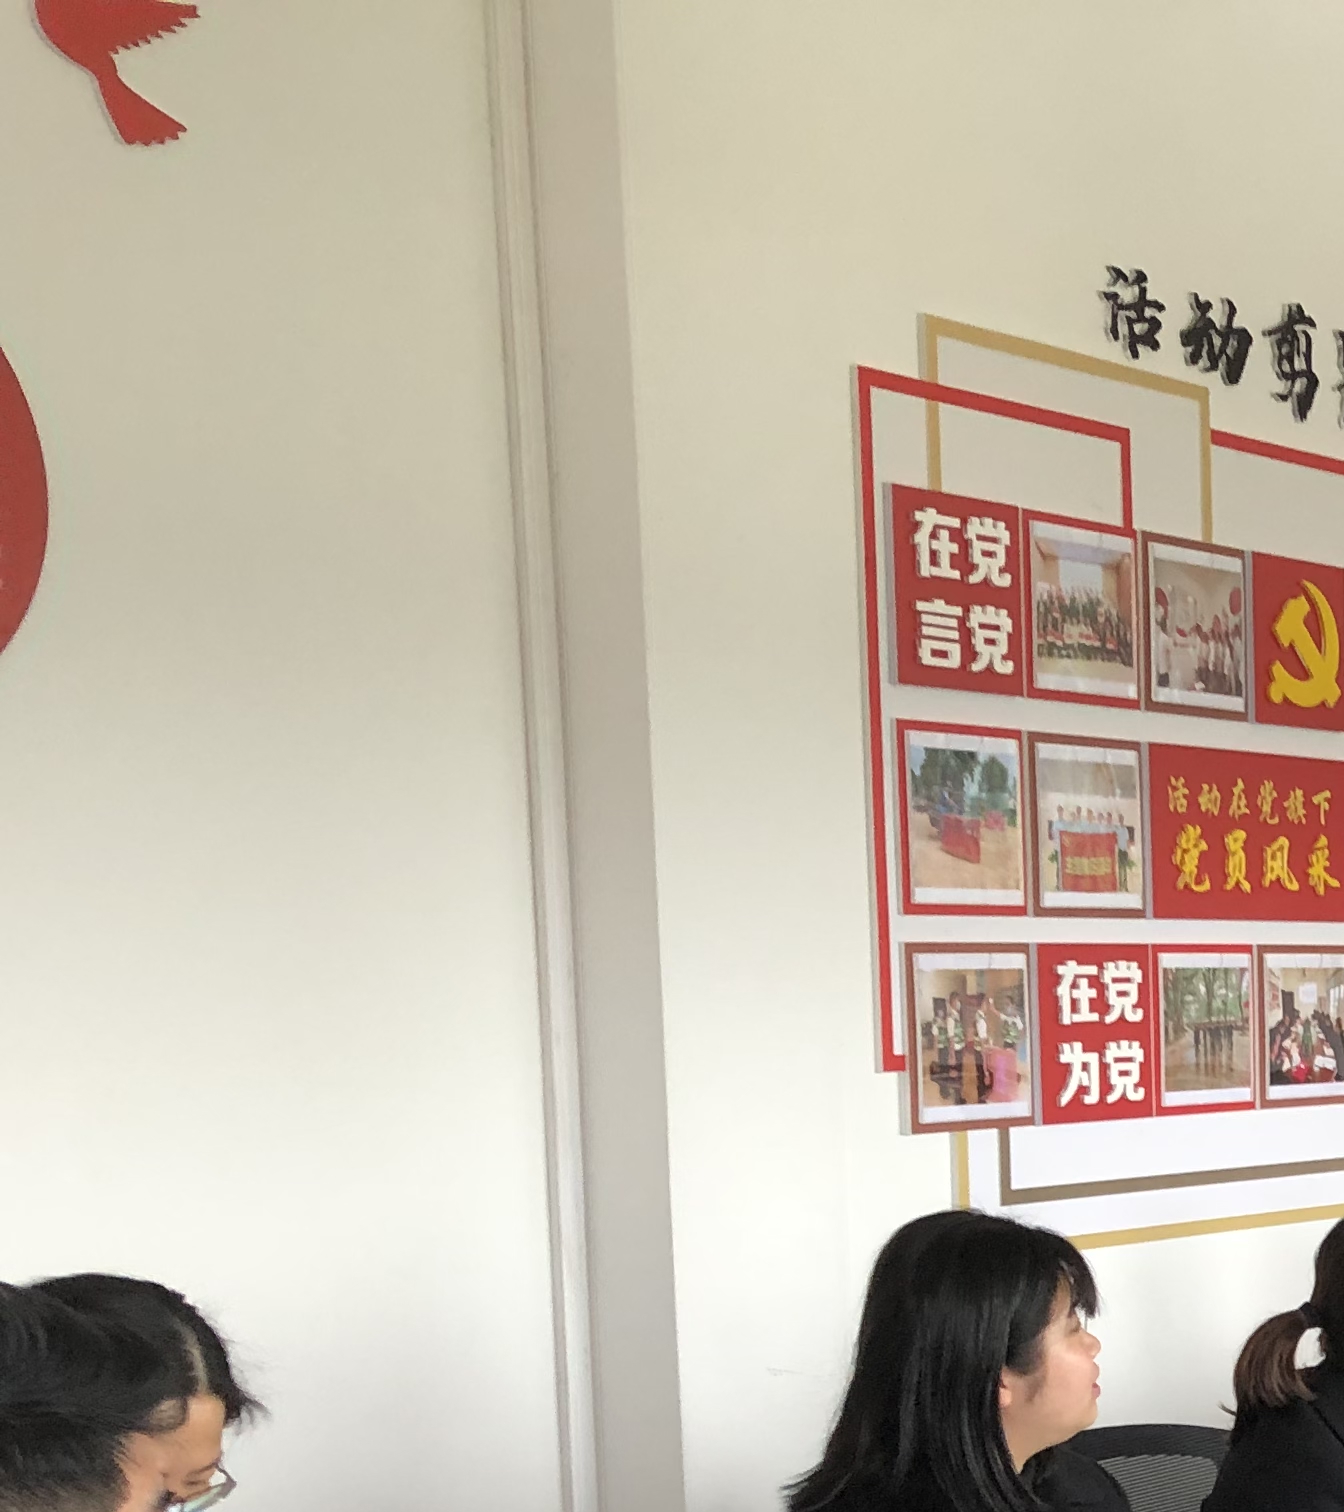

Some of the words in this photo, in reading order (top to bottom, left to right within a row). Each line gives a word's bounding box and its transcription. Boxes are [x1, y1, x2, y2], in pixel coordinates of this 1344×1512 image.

[912, 506, 1013, 589] 在党
[914, 598, 1015, 676] 言党
[1167, 775, 1332, 826] 活动在党旗下
[1171, 823, 1341, 897] 党员风采
[1055, 960, 1143, 1026] 在党
[1057, 1040, 1146, 1107] 为党
